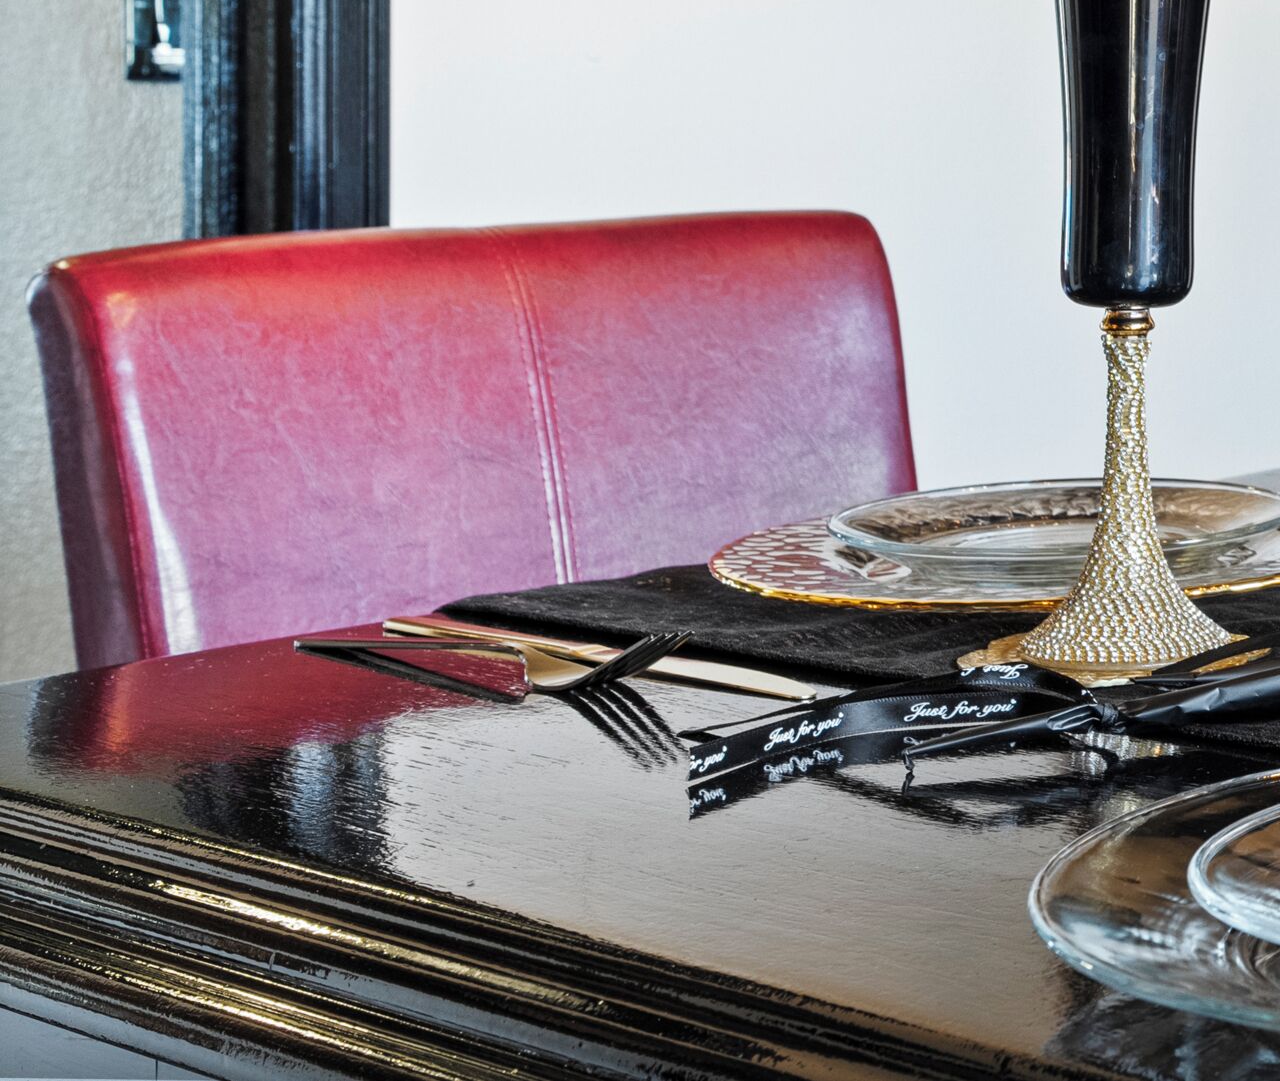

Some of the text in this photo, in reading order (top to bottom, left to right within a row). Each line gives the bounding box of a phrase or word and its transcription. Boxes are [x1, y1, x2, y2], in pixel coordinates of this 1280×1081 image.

[904, 700, 1015, 722] Just for you
[764, 716, 842, 751] Just for you
[699, 750, 726, 772] you
